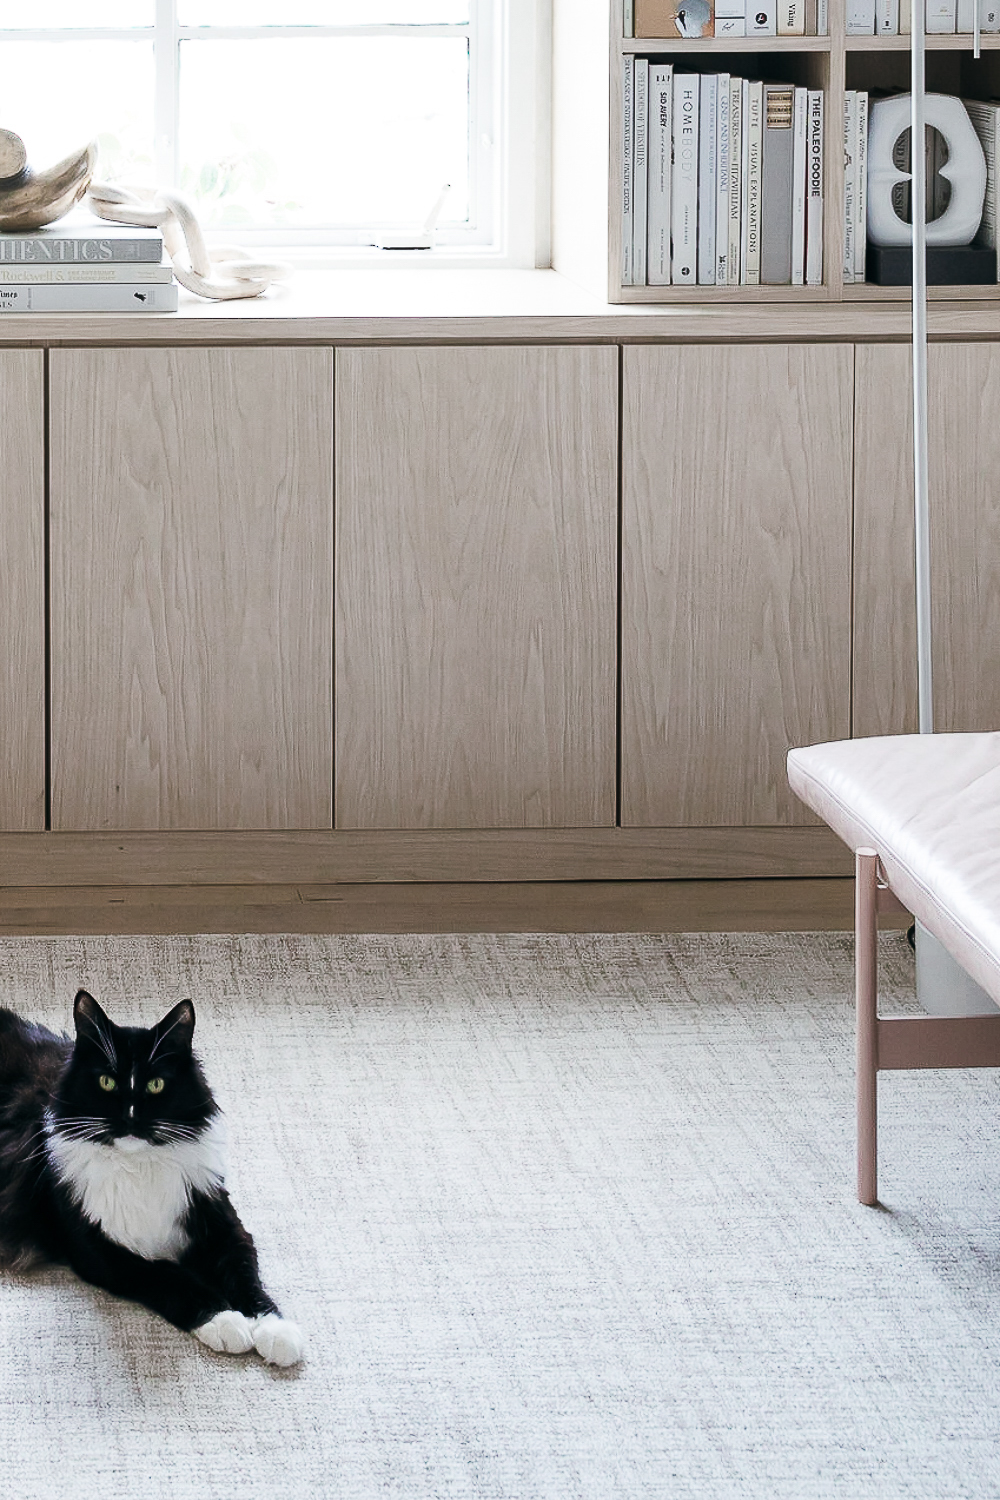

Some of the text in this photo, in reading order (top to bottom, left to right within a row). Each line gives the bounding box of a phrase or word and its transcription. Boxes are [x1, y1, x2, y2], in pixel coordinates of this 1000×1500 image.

[750, 143, 758, 175] VISUAL
[812, 97, 821, 197] THE PALEO FOODIE
